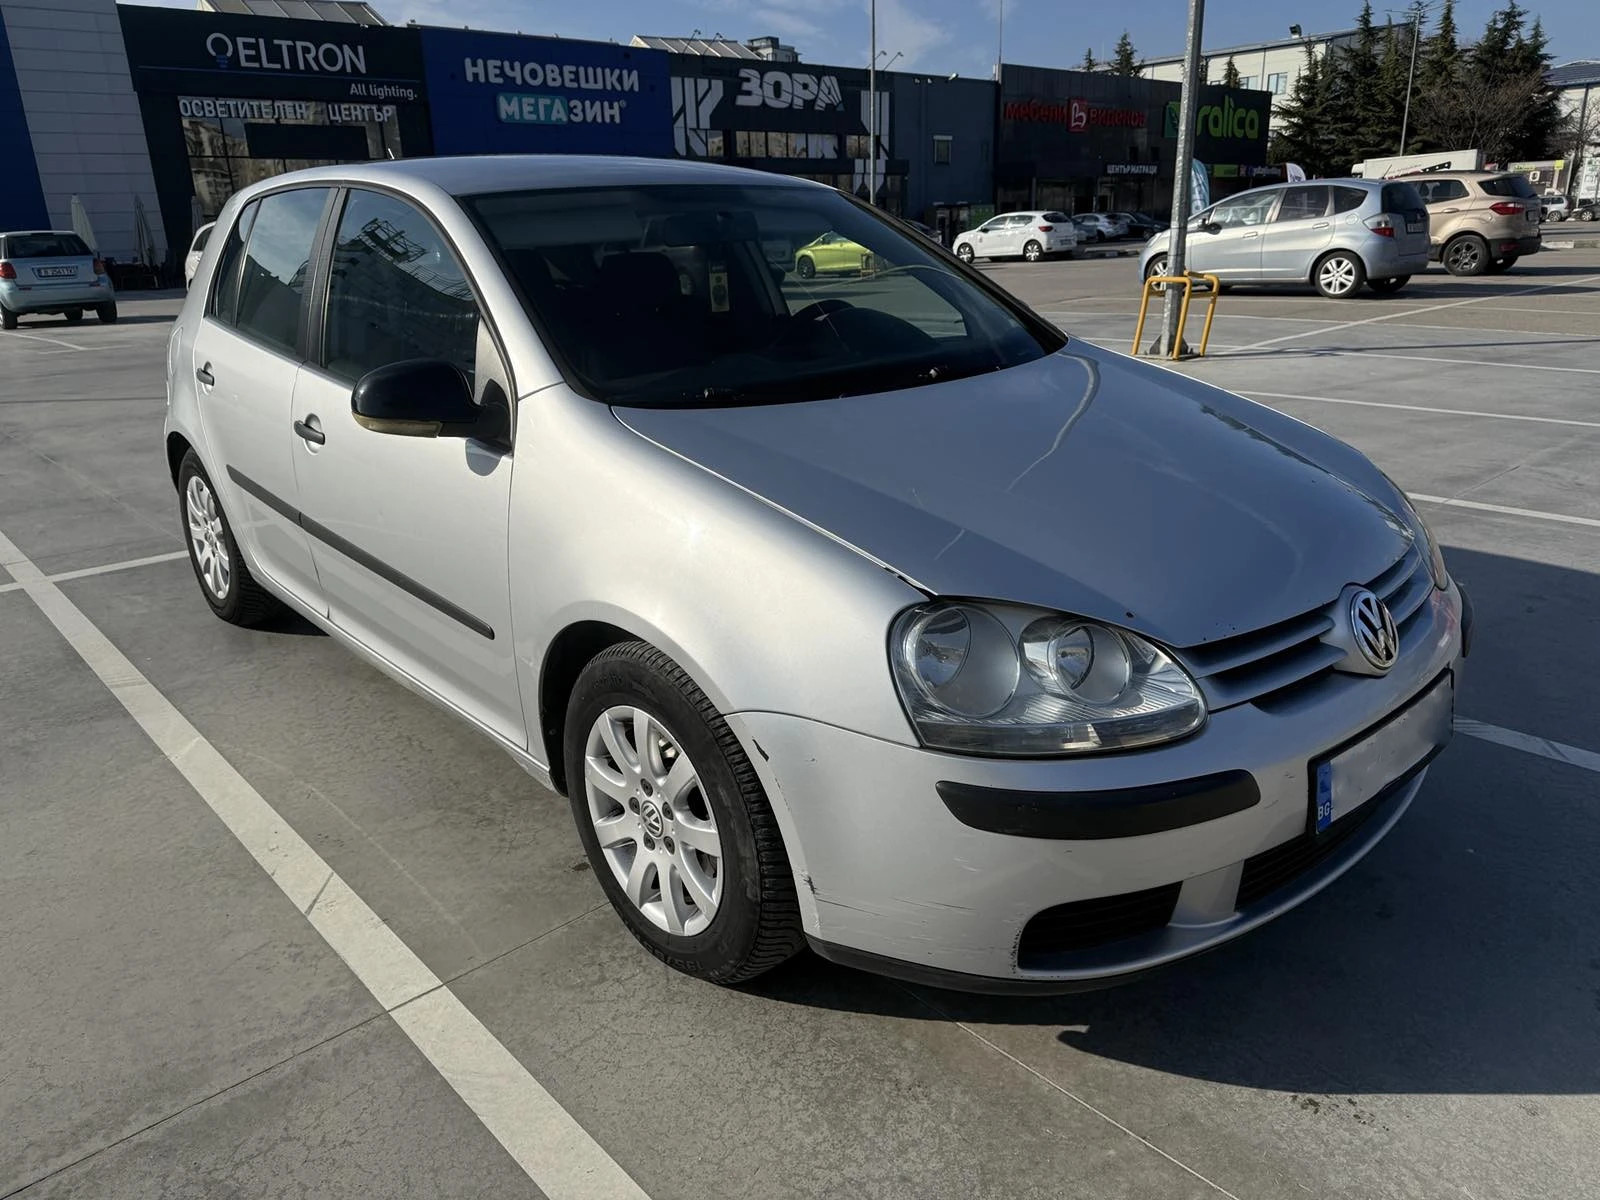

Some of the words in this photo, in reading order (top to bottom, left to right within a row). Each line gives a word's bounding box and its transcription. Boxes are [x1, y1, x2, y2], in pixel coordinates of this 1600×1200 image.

[464, 57, 640, 93] НЕЧОВЕШКИ
[350, 83, 367, 96] All
[370, 84, 418, 101] lighting.
[735, 68, 845, 111] ЗОРА
[178, 98, 307, 120] ОСВЕТИТЕЛЕН
[328, 103, 393, 124] ЦЕНТЪР
[1317, 802, 1331, 821] BG
